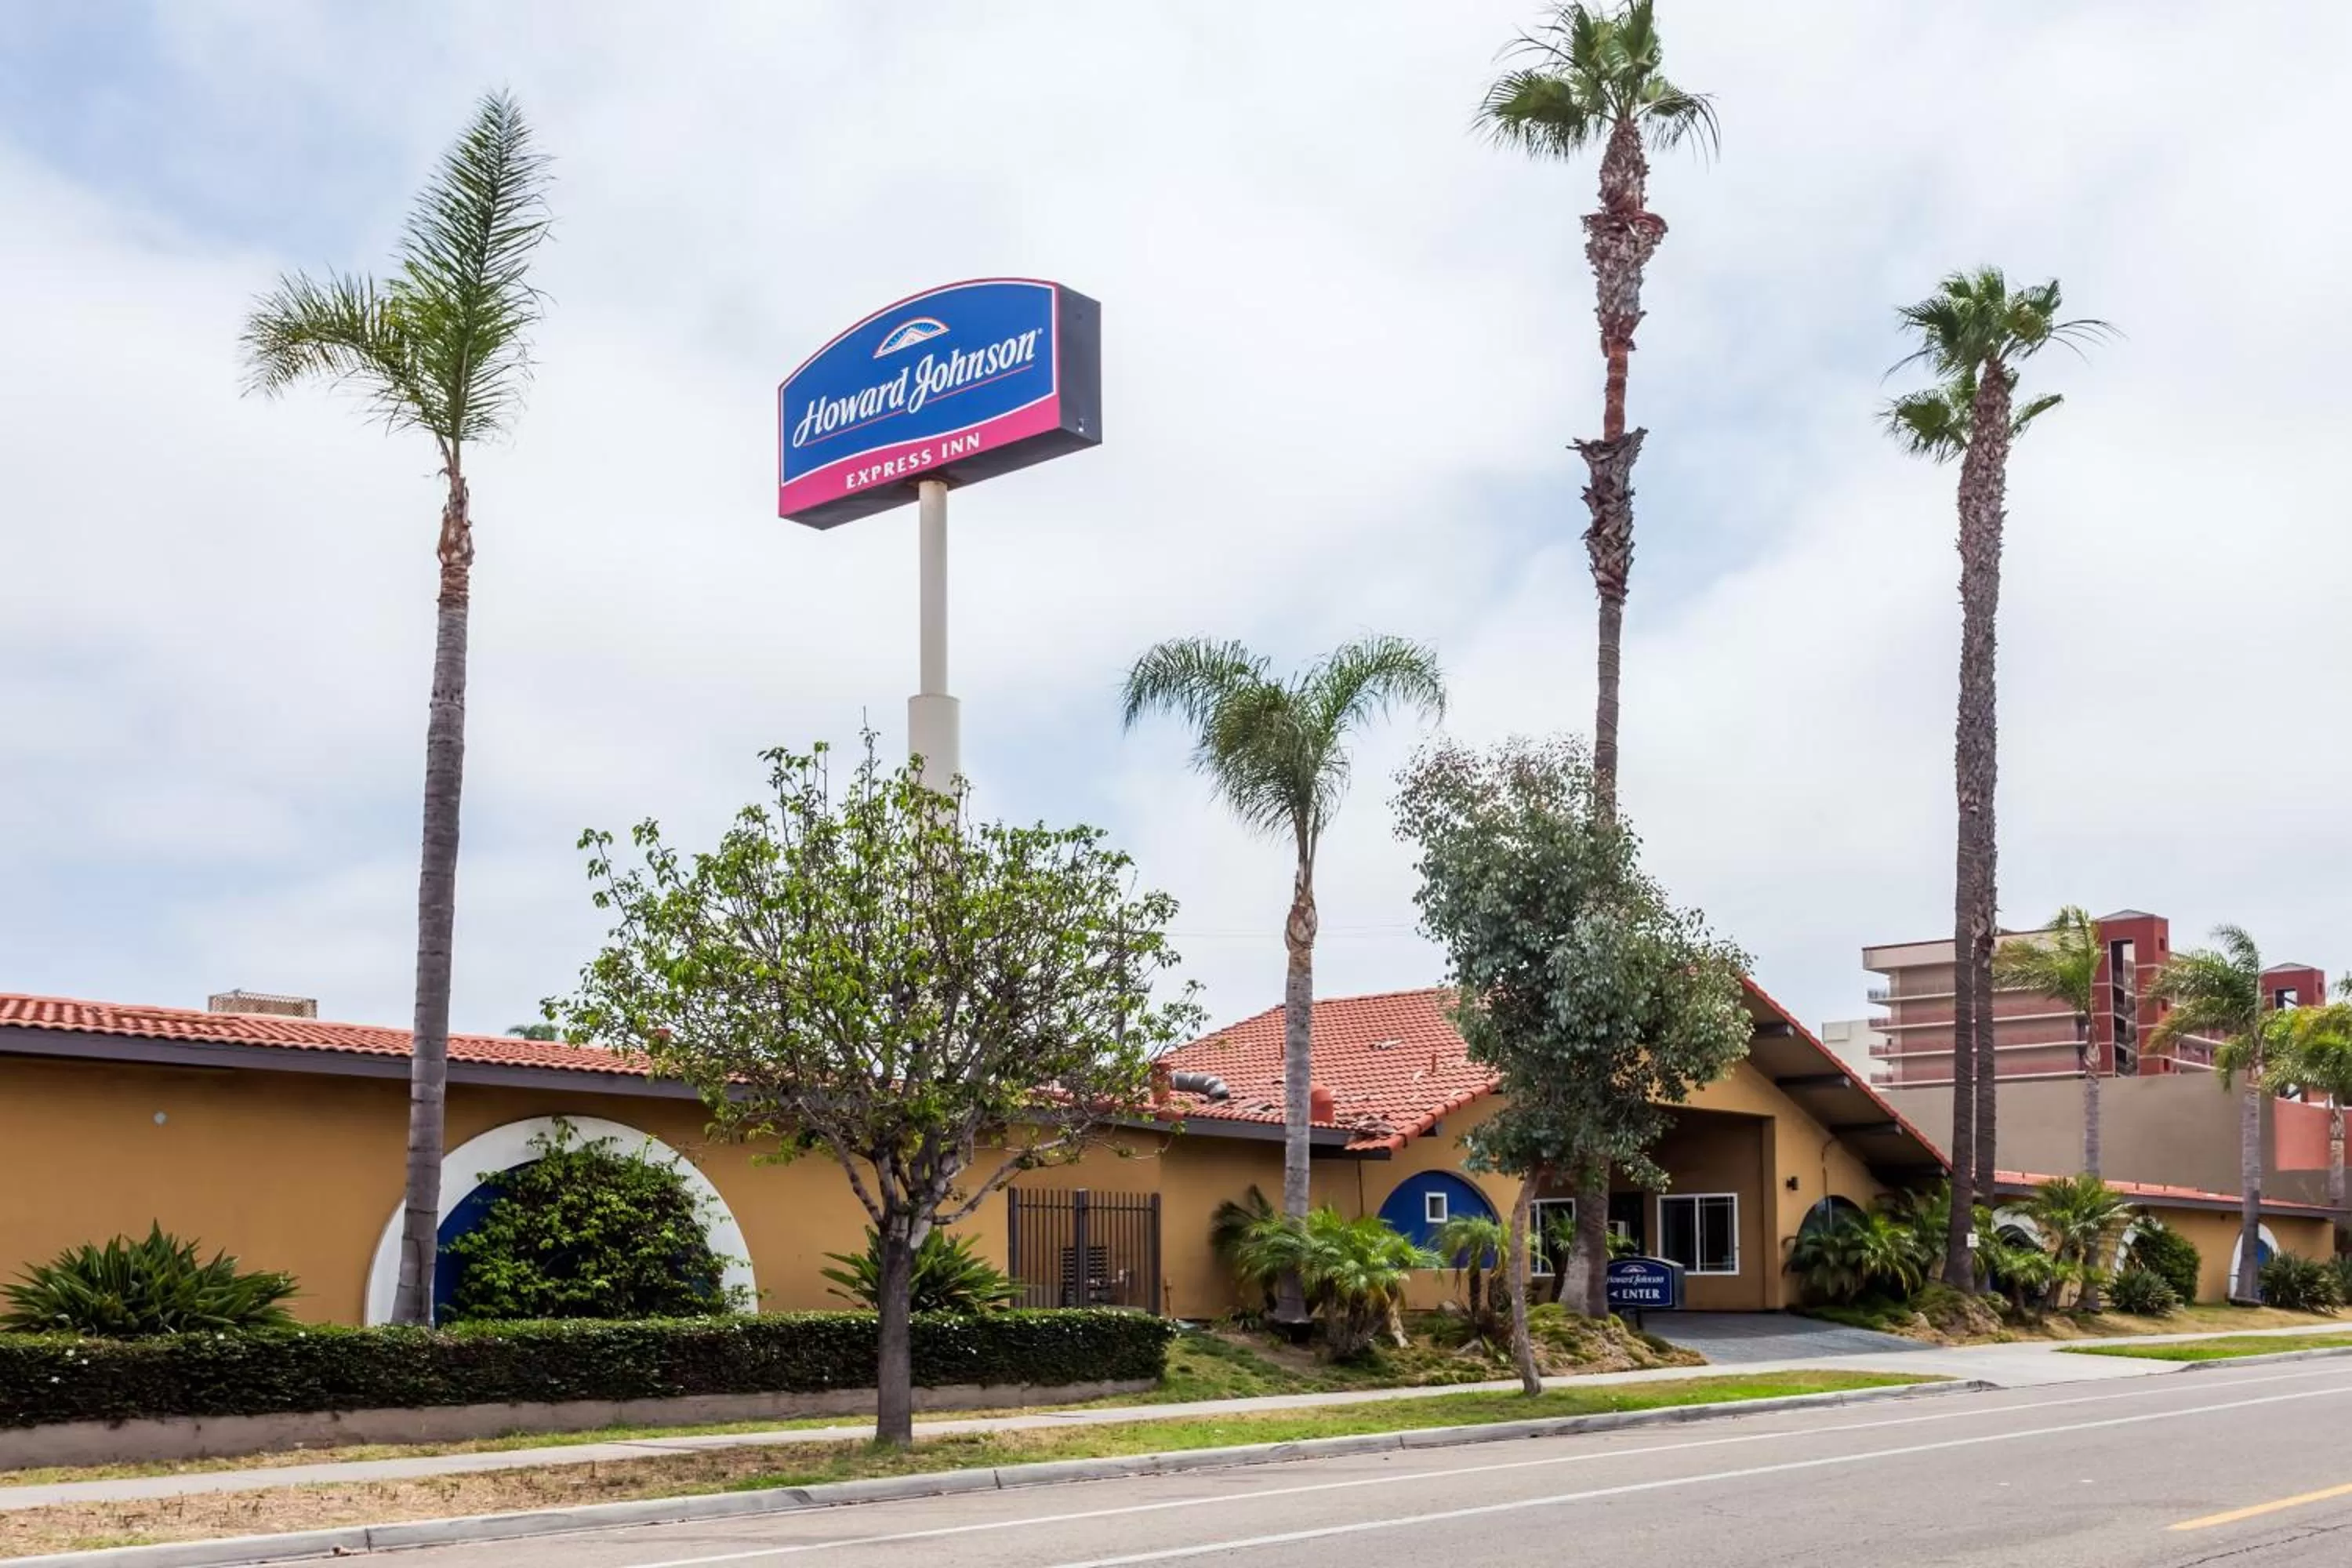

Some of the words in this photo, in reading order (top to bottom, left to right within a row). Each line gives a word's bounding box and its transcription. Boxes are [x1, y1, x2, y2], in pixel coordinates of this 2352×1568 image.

[793, 366, 909, 448] Howard
[907, 329, 1036, 414] Johnson
[846, 448, 933, 490] EXPRESS
[941, 432, 980, 459] INN
[1622, 1288, 1661, 1299] ENTER
[1632, 1275, 1664, 1287] Johnson
